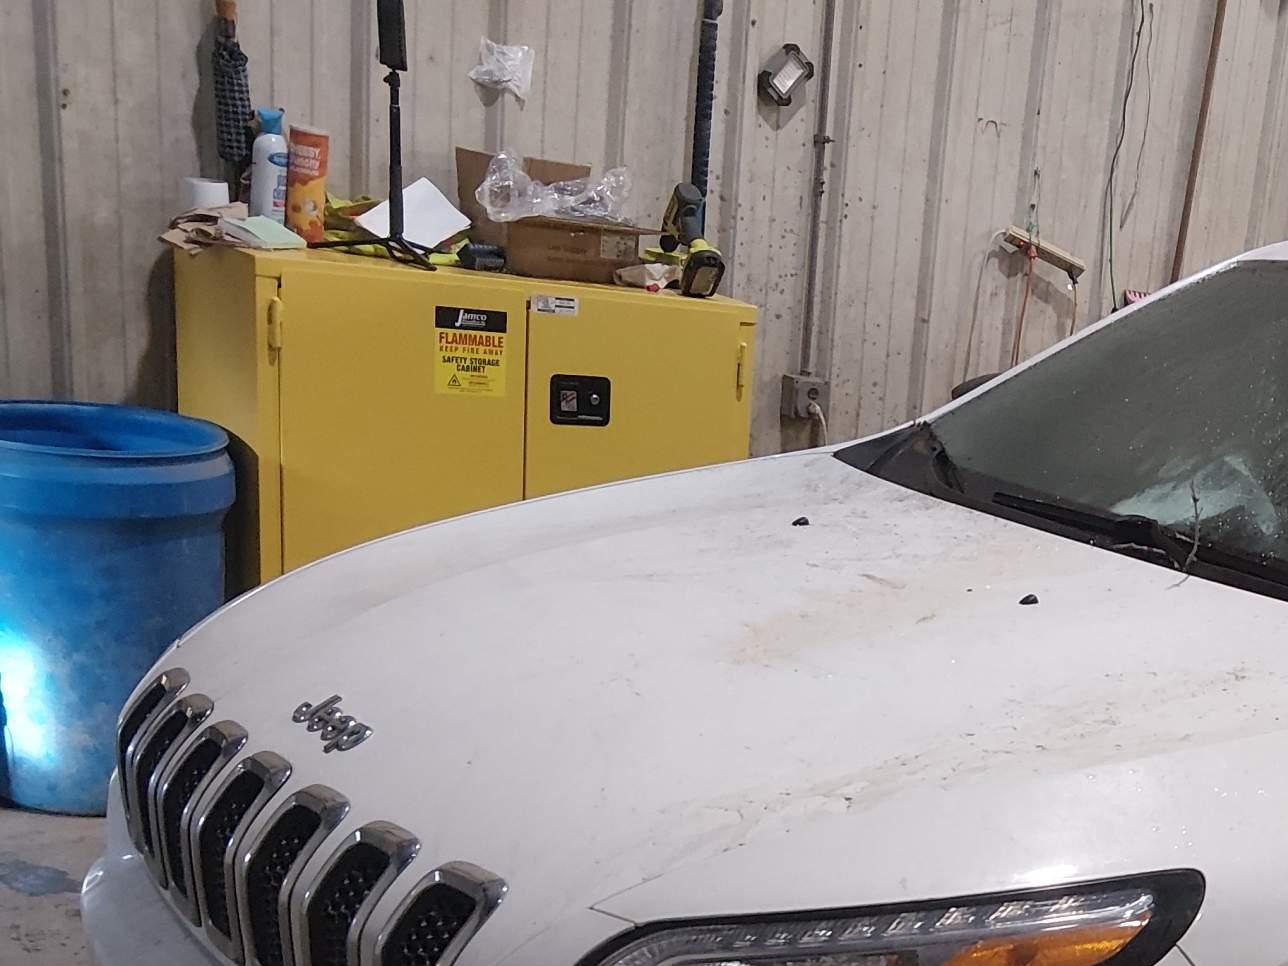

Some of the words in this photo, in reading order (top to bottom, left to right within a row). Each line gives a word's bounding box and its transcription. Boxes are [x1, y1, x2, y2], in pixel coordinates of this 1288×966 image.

[439, 332, 504, 348] FLAMMABLE
[483, 348, 503, 356] AWAY
[442, 355, 467, 365] SAFETY
[469, 357, 500, 367] STORAGE
[456, 364, 486, 374] CABINET
[292, 694, 374, 754] Jeep
